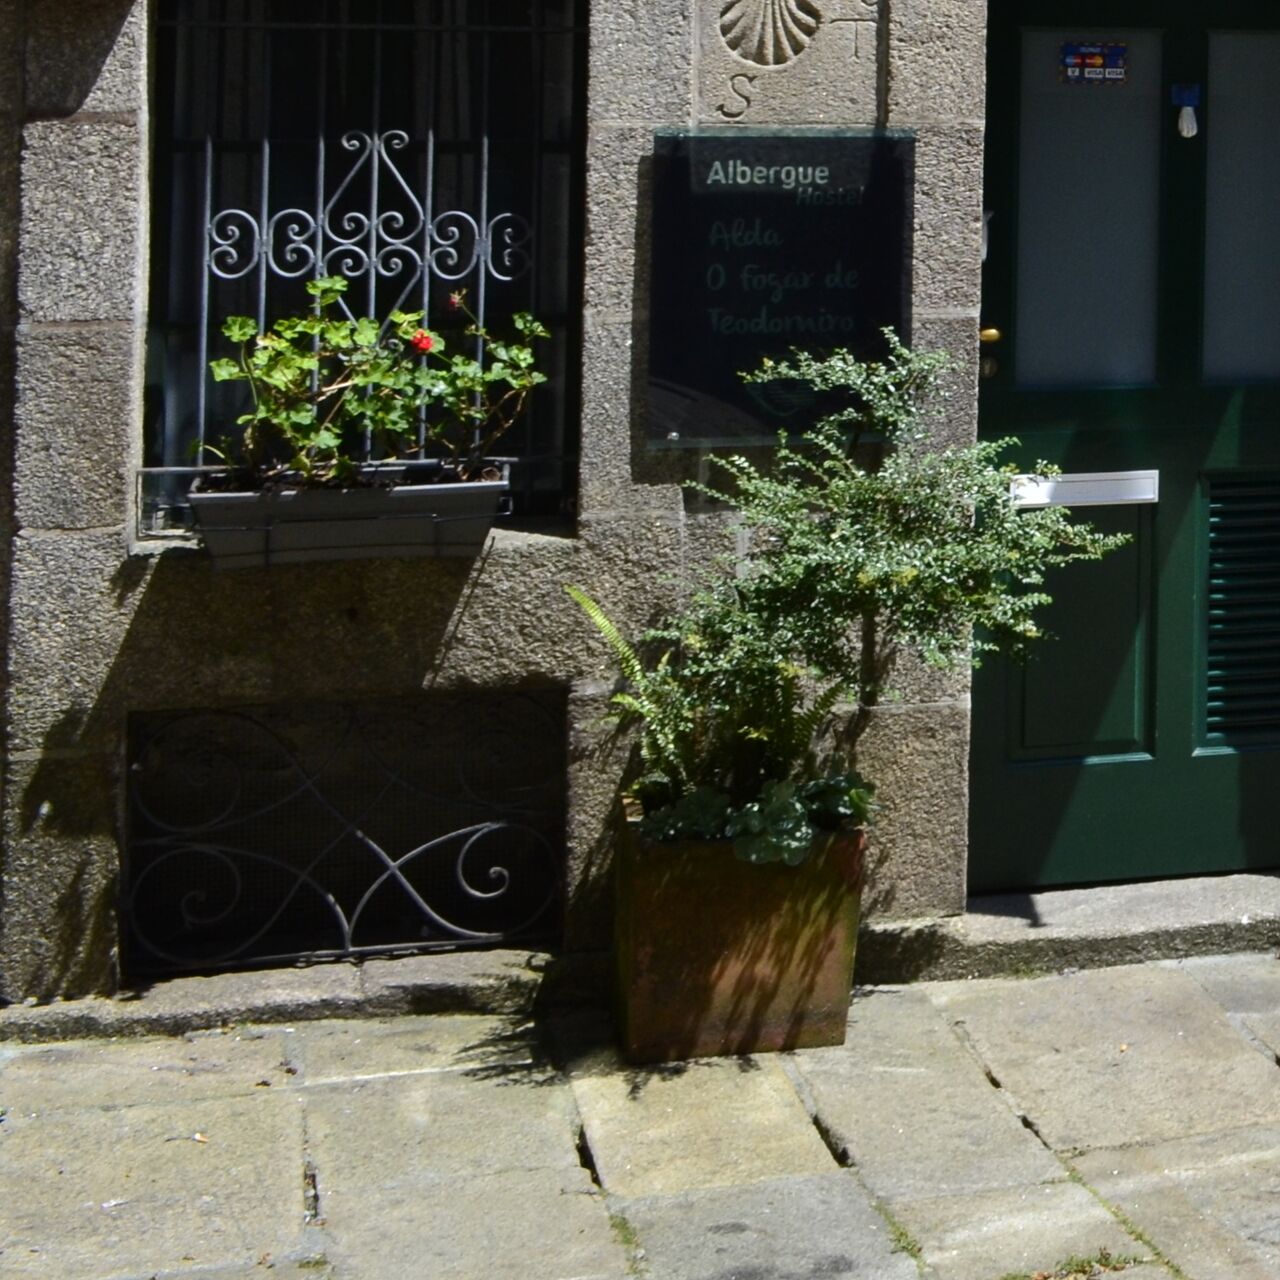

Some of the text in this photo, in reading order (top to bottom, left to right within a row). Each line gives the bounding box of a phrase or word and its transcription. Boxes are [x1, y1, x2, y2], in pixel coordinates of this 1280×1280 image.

[706, 159, 830, 190] Albergue
[795, 185, 865, 207] Hostel
[708, 218, 784, 253] Alda
[705, 263, 726, 291] O
[824, 259, 859, 289] de
